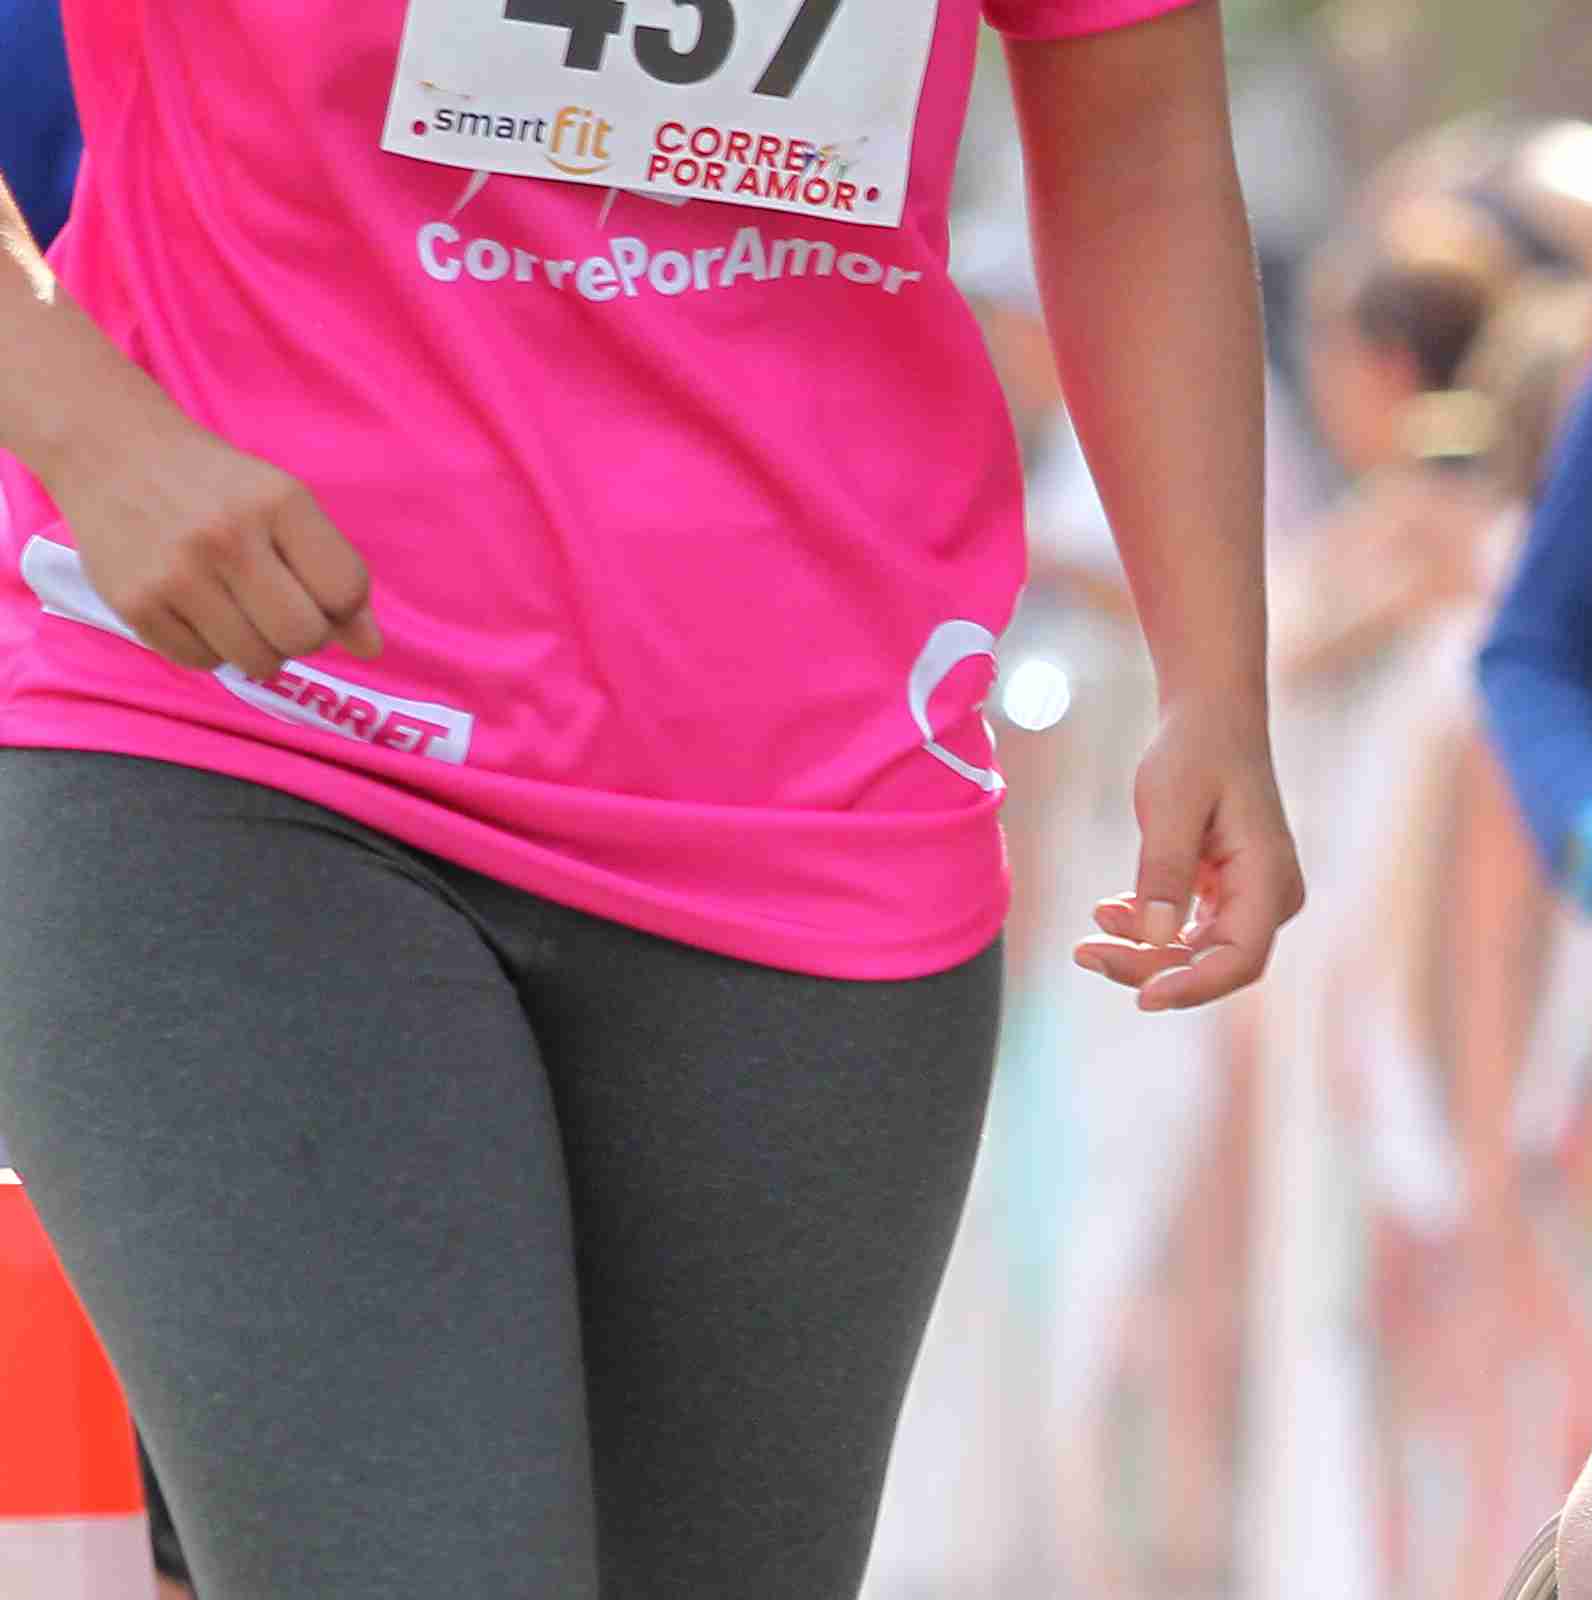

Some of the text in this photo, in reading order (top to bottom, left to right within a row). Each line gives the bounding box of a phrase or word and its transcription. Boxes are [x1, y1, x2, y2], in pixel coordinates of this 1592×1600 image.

[654, 121, 816, 172] CORRE
[646, 153, 858, 212] POR AMOR
[415, 221, 921, 302] CorrePorAmor
[250, 669, 449, 757] ERRET
